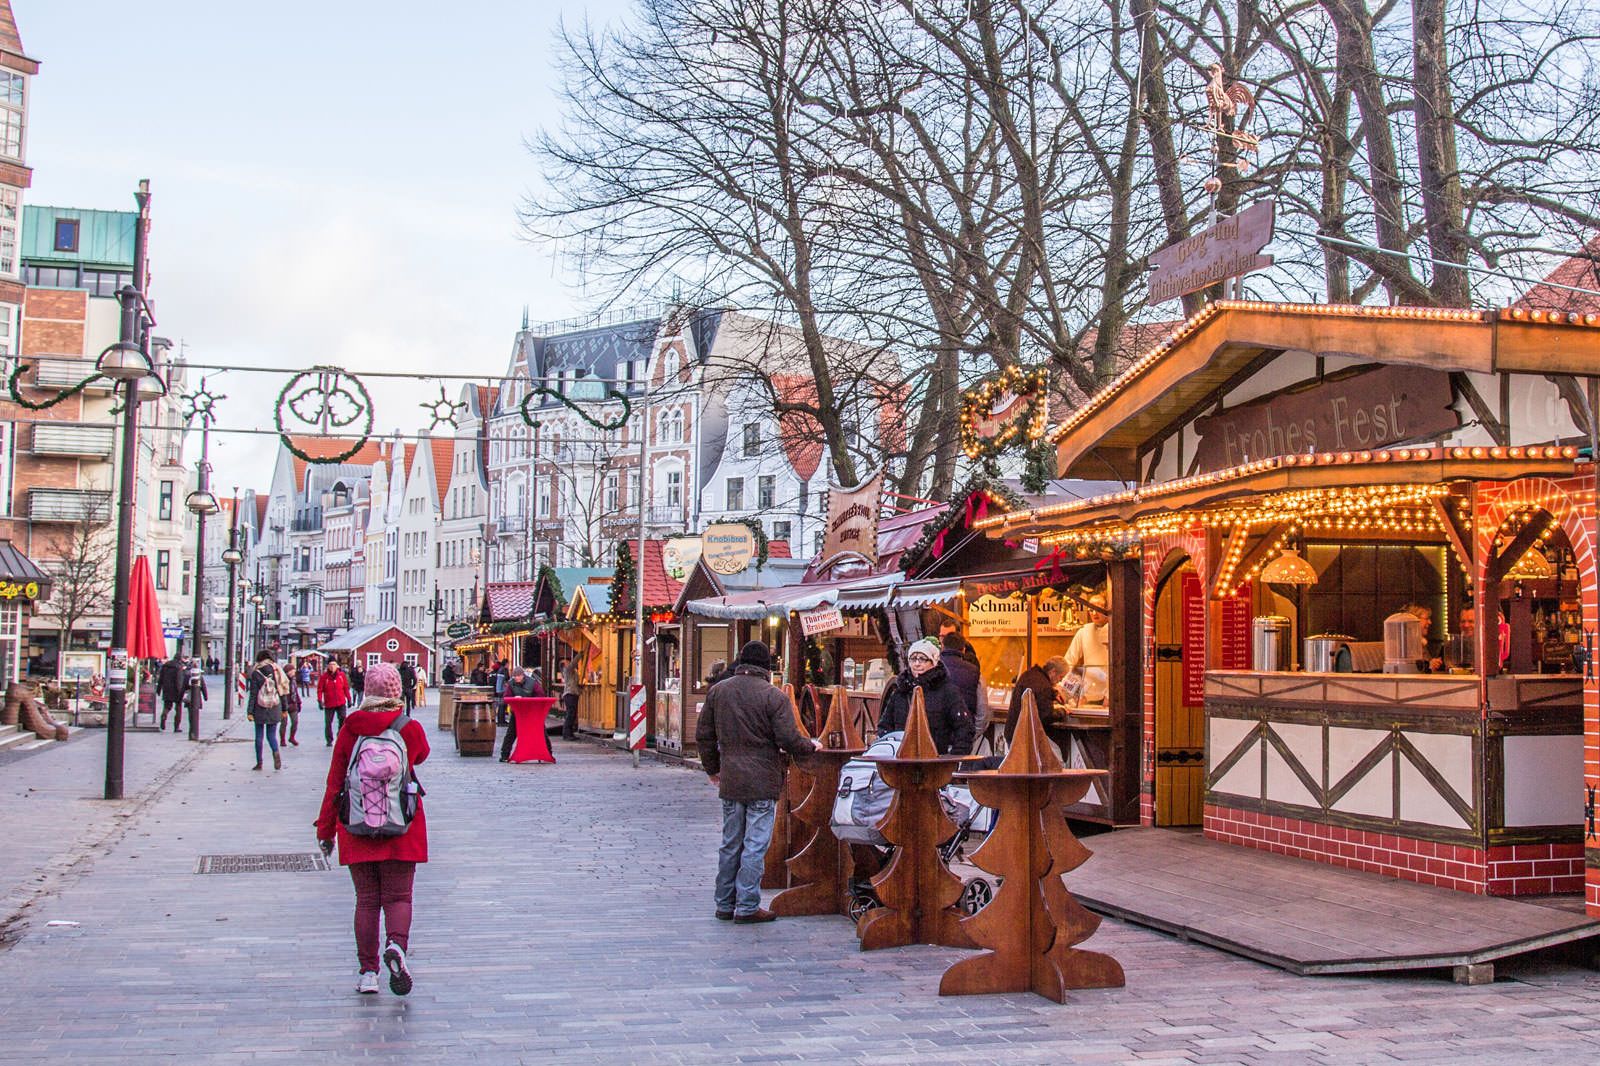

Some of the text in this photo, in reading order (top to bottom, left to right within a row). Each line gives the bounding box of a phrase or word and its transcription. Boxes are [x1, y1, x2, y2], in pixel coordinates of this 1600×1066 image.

[1222, 392, 1406, 468] Frohes Fest
[803, 610, 838, 625] Thüringer
[971, 618, 997, 626] Portion
